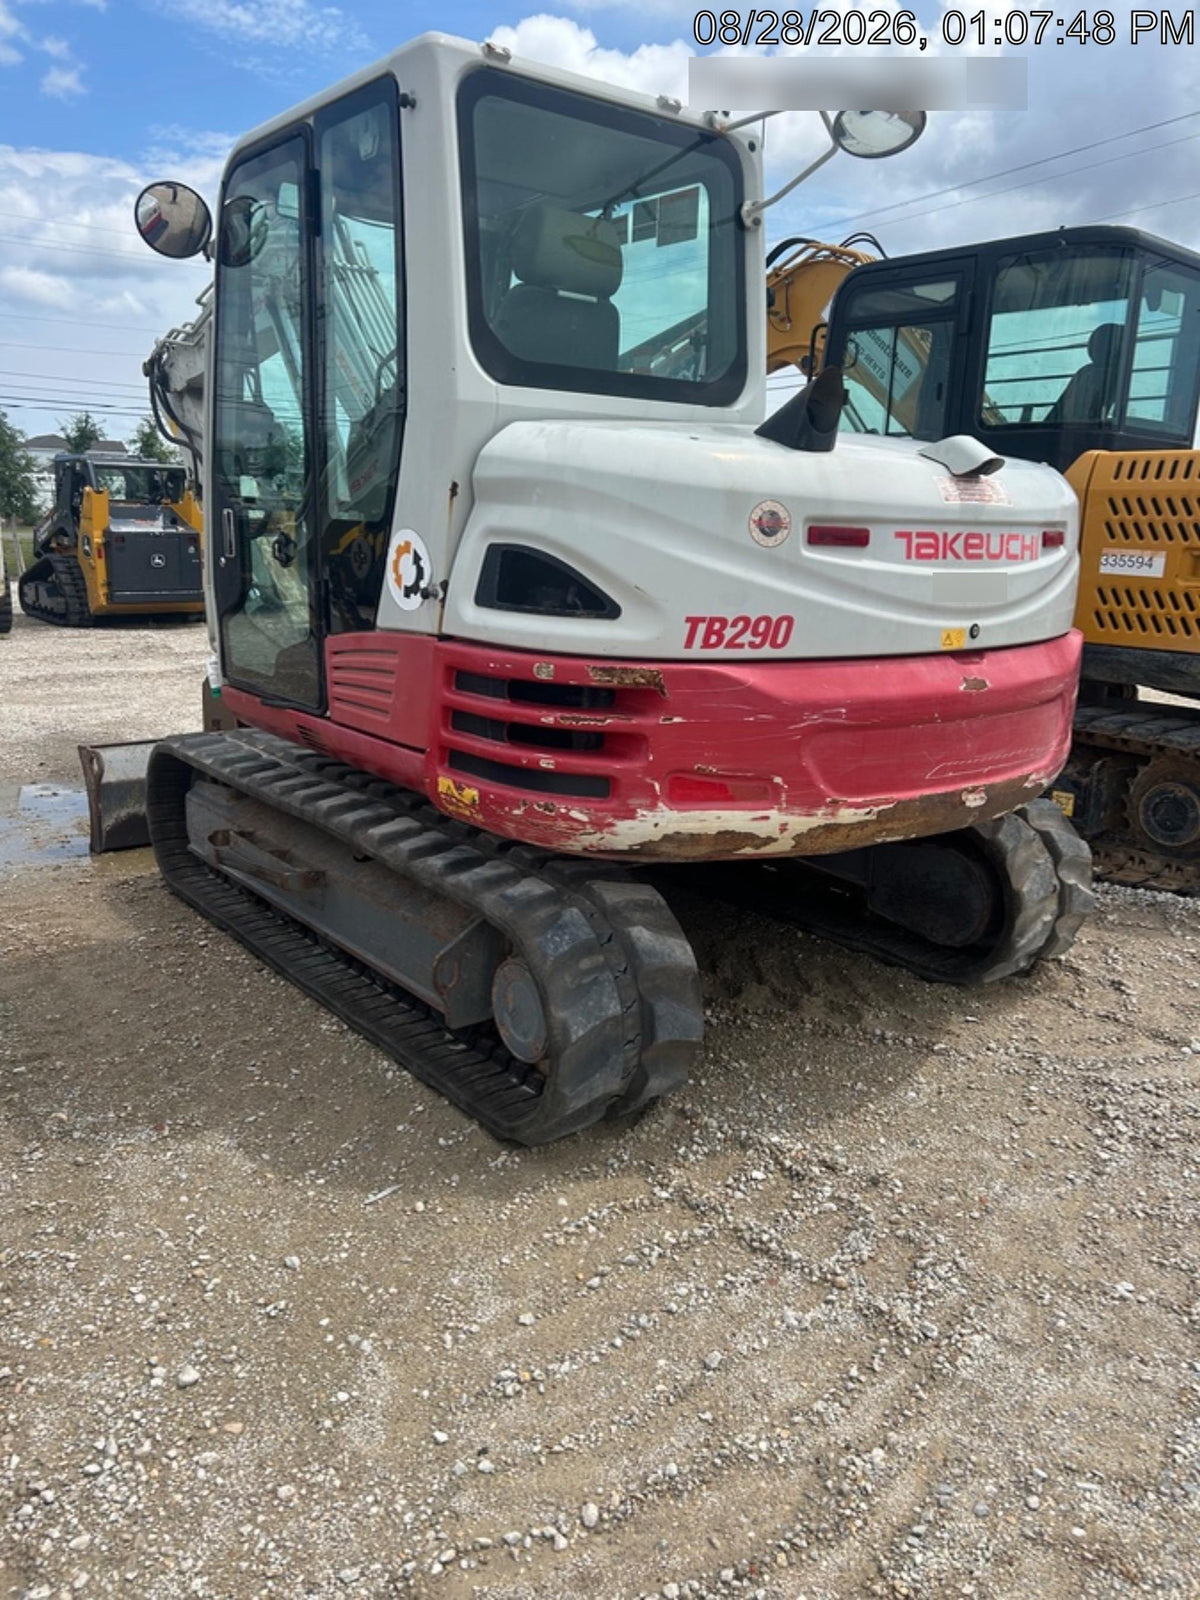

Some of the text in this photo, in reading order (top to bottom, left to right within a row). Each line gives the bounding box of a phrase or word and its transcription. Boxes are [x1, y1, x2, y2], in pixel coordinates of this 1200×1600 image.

[894, 530, 1039, 561] TAKEUCHI
[1100, 553, 1154, 570] 335594
[683, 614, 795, 650] TB290
